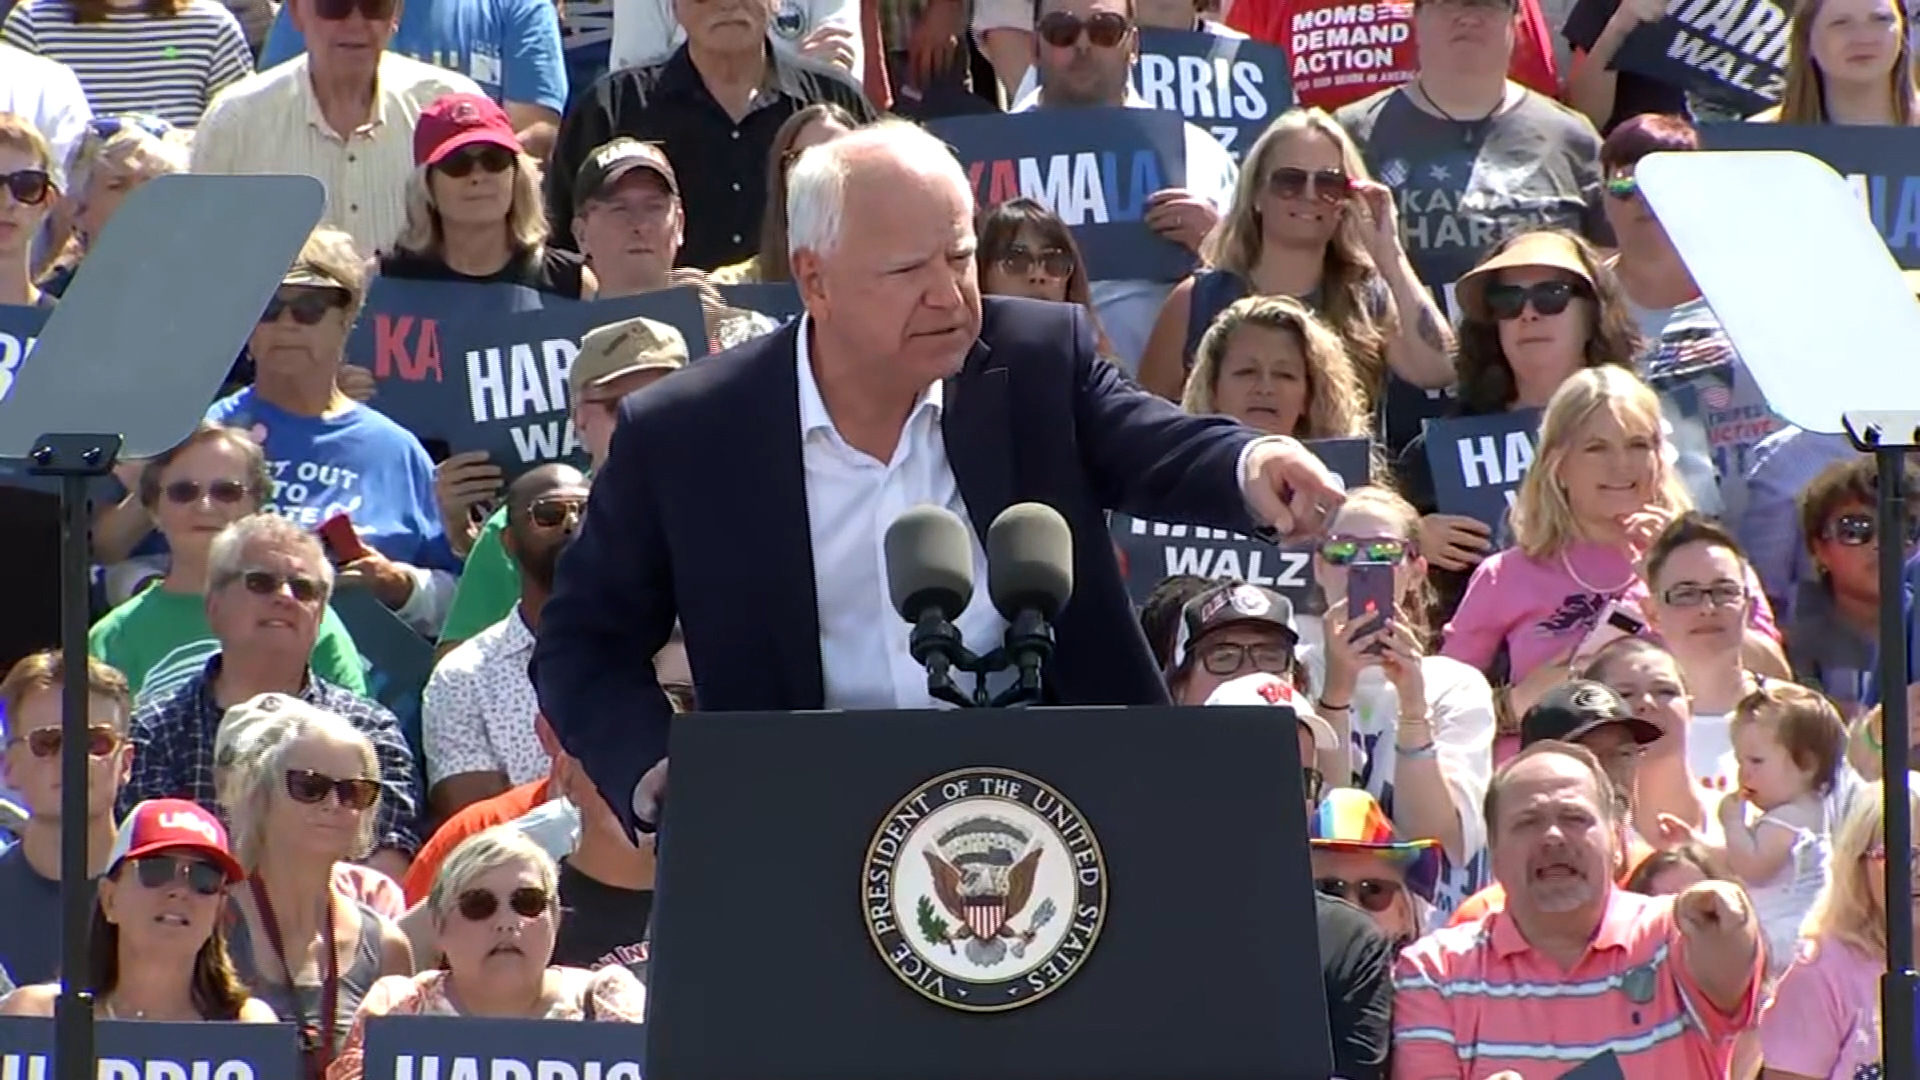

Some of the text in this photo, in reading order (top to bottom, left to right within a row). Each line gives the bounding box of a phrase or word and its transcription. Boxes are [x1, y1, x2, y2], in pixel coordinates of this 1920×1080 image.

[1292, 4, 1376, 31] MOMS
[1291, 23, 1410, 54] DEMAND
[1292, 48, 1394, 77] ACTION
[1666, 30, 1788, 101] WALZ
[297, 461, 358, 489] OUT
[270, 480, 308, 503] TO
[1165, 546, 1310, 587] WALZ
[868, 778, 1099, 997] VICE PRESIDENT OF THE UNITED STATES
